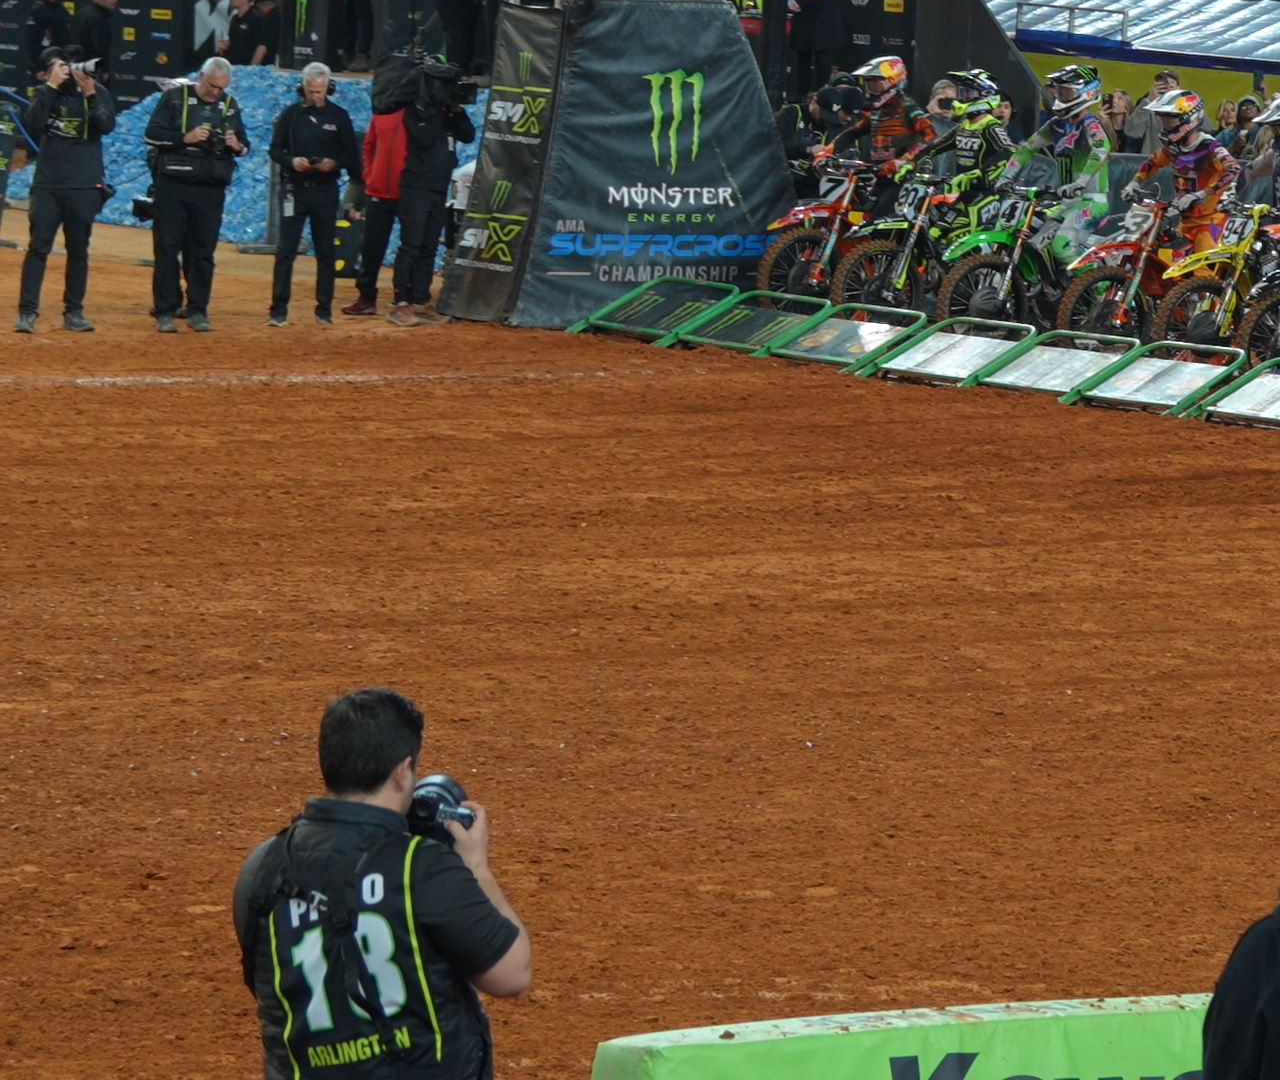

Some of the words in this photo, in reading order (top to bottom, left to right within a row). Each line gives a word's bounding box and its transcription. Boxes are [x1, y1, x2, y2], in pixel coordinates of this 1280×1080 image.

[488, 96, 546, 134] SMX
[608, 183, 735, 208] MONSTER
[820, 179, 846, 196] 7
[627, 213, 717, 223] ENERGY
[1002, 201, 1020, 223] 4
[556, 220, 585, 233] AMA
[1224, 220, 1247, 239] 94
[459, 221, 522, 262] SMX
[599, 265, 738, 283] CHAMPIONSHIP
[291, 911, 408, 1033] 18
[307, 1026, 411, 1069] ARLINGTN
